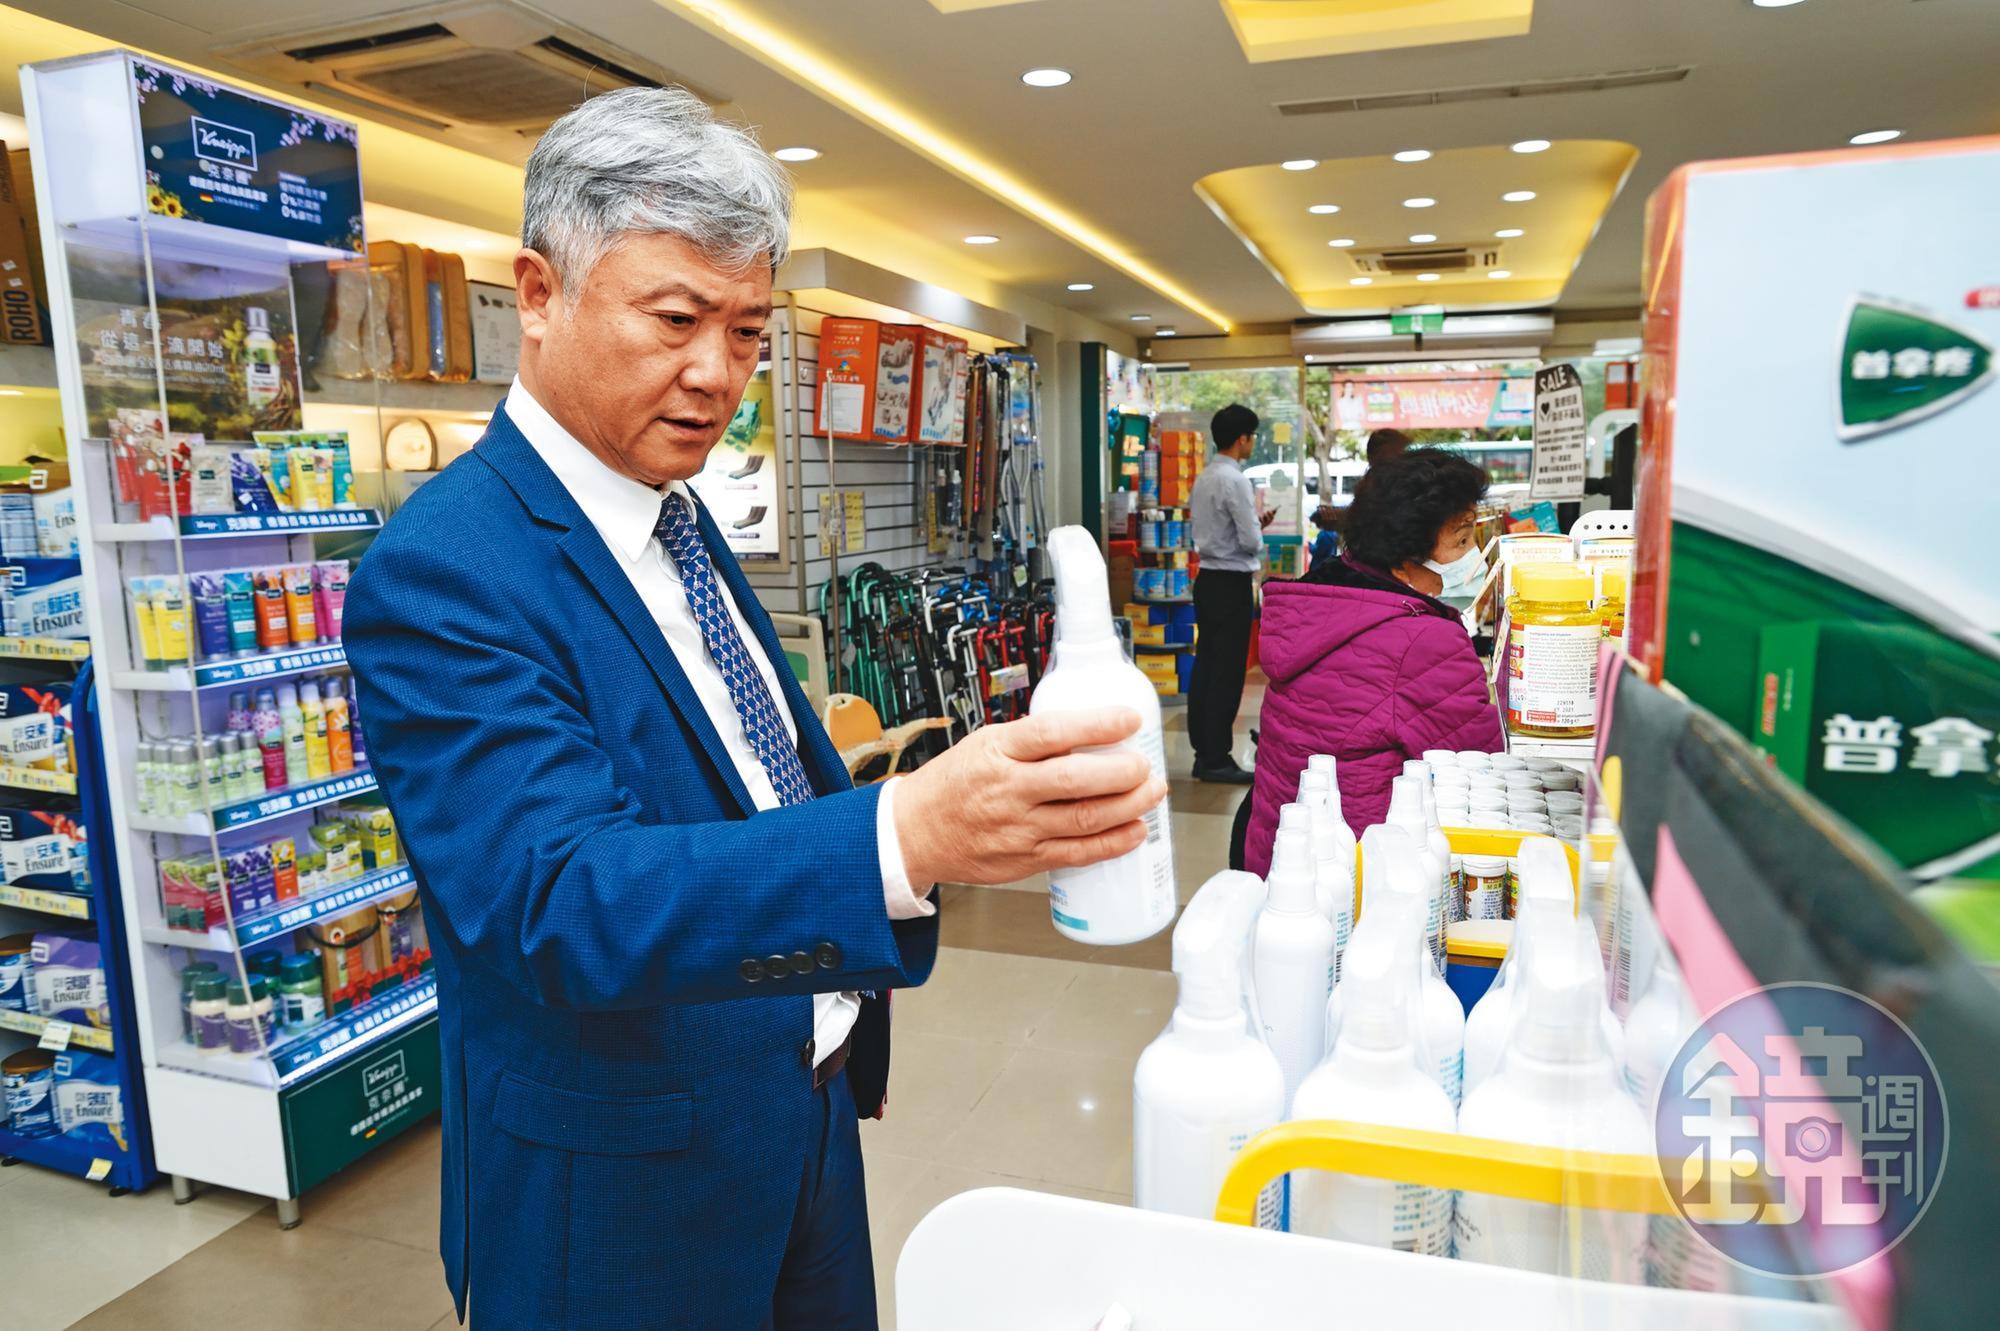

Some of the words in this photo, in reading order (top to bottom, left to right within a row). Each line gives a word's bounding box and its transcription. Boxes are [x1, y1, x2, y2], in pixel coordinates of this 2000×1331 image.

[198, 127, 250, 159] Kneipp
[3, 290, 36, 341] ROHO
[100, 330, 223, 359] 從這一滴開始
[1540, 366, 1567, 391] SALE
[54, 514, 77, 529] Ens
[32, 610, 83, 634] Ensure
[13, 734, 49, 753] Ensure
[1821, 714, 2000, 777] 普拿
[24, 851, 64, 872] Ensure
[53, 988, 91, 1003] Ensure
[75, 1103, 114, 1118] Ensure
